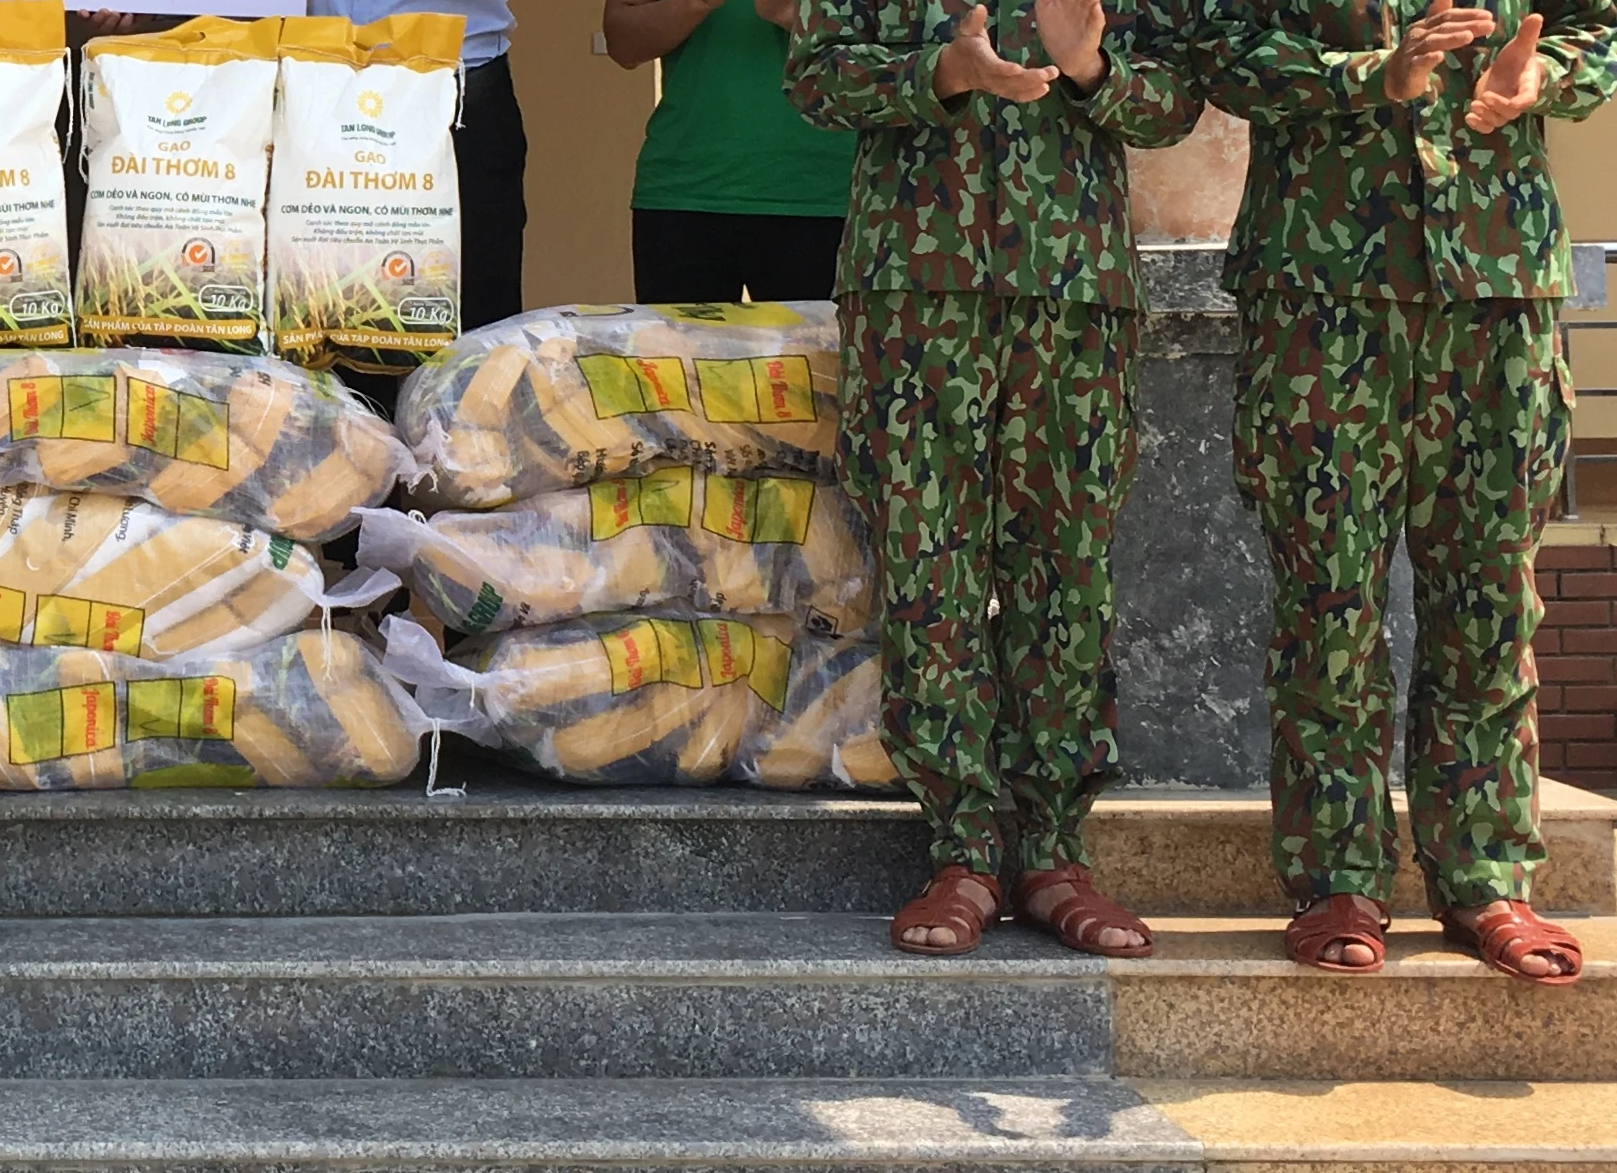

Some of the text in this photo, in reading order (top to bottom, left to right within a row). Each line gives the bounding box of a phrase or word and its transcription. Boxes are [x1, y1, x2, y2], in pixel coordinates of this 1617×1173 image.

[111, 151, 236, 180] ĐÀI THƠM 8
[354, 151, 386, 166] GẠO
[20, 169, 30, 186] 8
[306, 167, 433, 190] ĐÀI THƠM 8
[126, 189, 138, 199] VÀ
[140, 191, 172, 201] NGON,
[212, 195, 239, 205] THƠM
[14, 201, 38, 212] THƠM
[323, 203, 336, 214] VÀ
[339, 206, 372, 215] NGON,
[412, 206, 437, 215] THƠM
[22, 301, 59, 317] 10 Kg
[211, 294, 226, 308] 10
[410, 307, 447, 325] 10 Kg
[39, 330, 64, 341] LONG
[227, 324, 252, 335] LONG
[139, 383, 158, 443] Japonica
[716, 623, 736, 679] Japonica
[80, 689, 101, 751] Japonica
